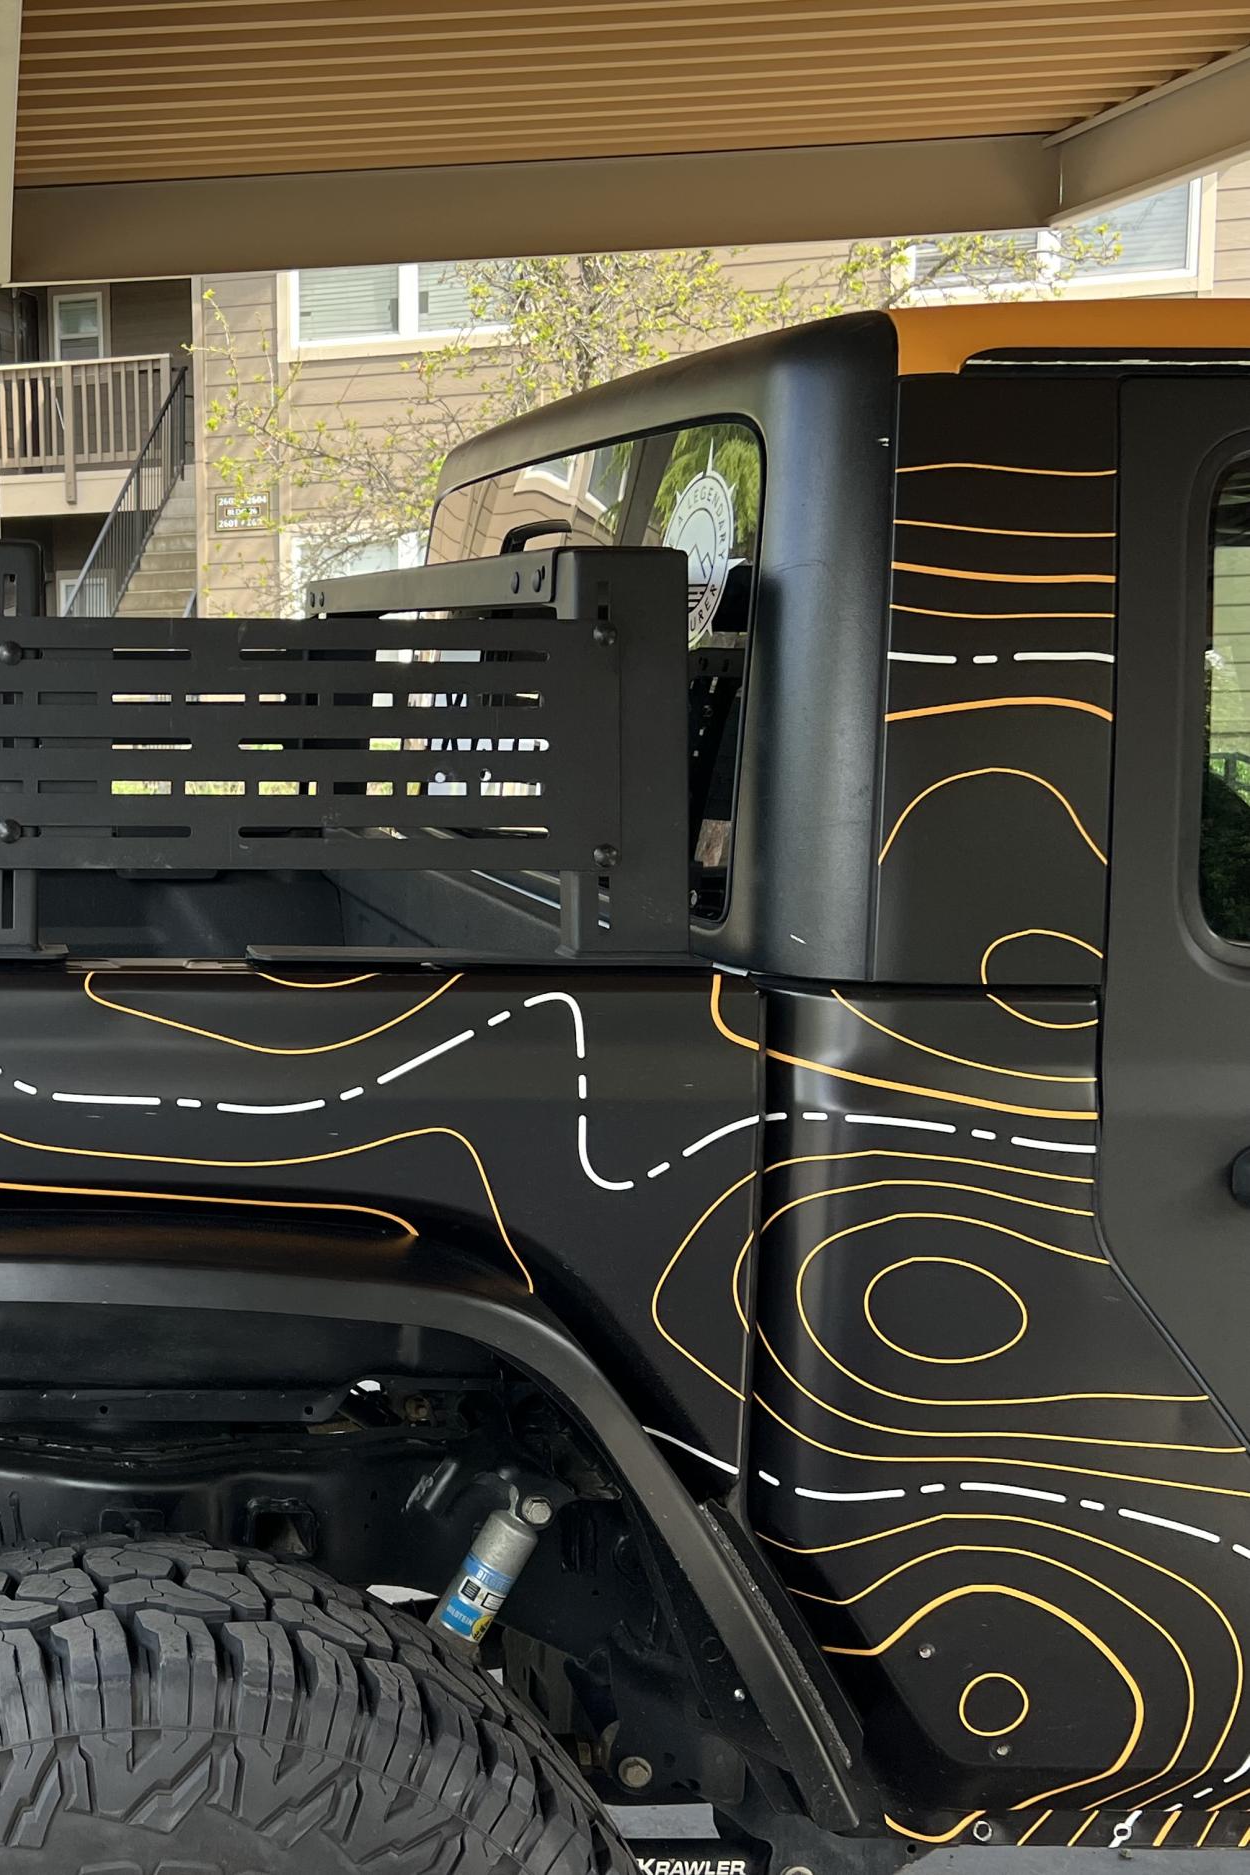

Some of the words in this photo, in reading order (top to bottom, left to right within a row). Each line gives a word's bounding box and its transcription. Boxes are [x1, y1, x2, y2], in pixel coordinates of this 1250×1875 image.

[218, 497, 237, 506] 260
[687, 485, 727, 560] LEGENDARY
[689, 584, 718, 632] URER
[636, 1858, 746, 1875] KRAWLER
